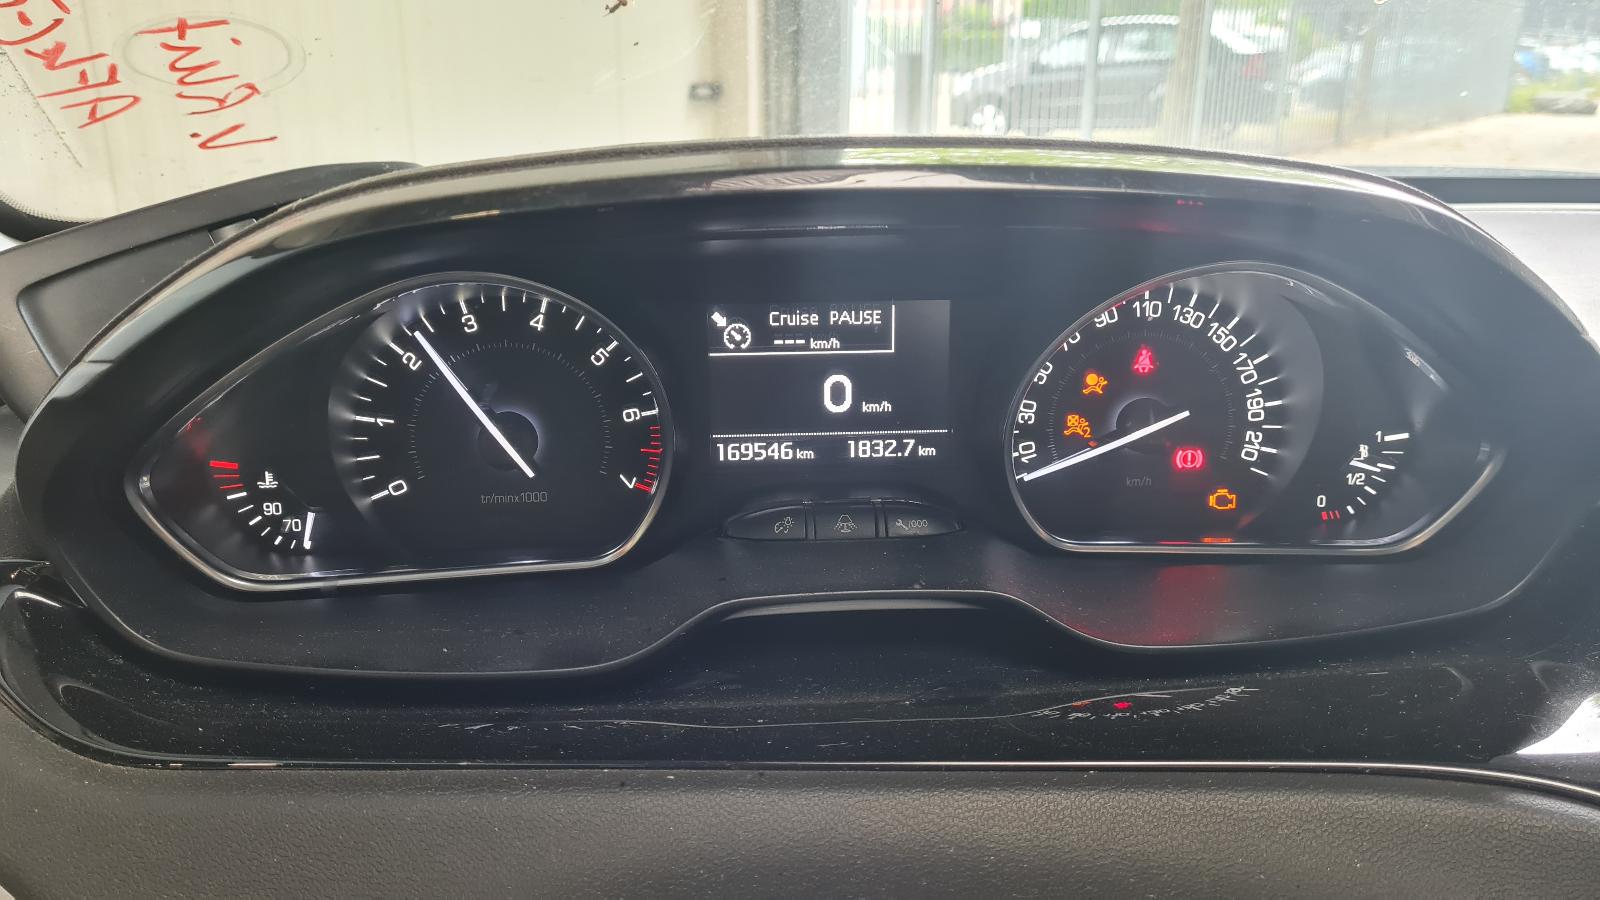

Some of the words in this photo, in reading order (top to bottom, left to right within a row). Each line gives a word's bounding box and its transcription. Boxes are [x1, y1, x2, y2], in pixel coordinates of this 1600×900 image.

[769, 311, 819, 326] Cruise
[830, 310, 882, 325] PAUSE
[1132, 301, 1163, 318] 110
[1172, 304, 1206, 329] 130
[461, 315, 478, 333] 3
[529, 315, 545, 331] 4
[810, 337, 841, 350] km/h
[1207, 322, 1238, 352] 150
[402, 352, 422, 371] 2
[590, 347, 610, 366] 5
[1232, 352, 1258, 385] 170
[823, 374, 852, 413] 0
[862, 401, 892, 413] km/h
[1018, 400, 1037, 424] 30
[1246, 388, 1265, 422] 190
[376, 417, 395, 427] 1
[622, 408, 641, 423] 6
[1375, 431, 1383, 443] 1
[716, 442, 793, 461] 169546
[796, 449, 815, 460] km
[848, 439, 916, 458] 1832.7
[918, 446, 936, 457] km
[1018, 441, 1036, 463] 10
[1241, 431, 1263, 462] 210
[388, 480, 408, 496] 0
[620, 474, 637, 489] 7
[1126, 476, 1152, 487] km/h
[1346, 473, 1365, 486] 1/2
[263, 502, 282, 515] 90
[1317, 495, 1326, 508] 0
[282, 518, 302, 532] 70
